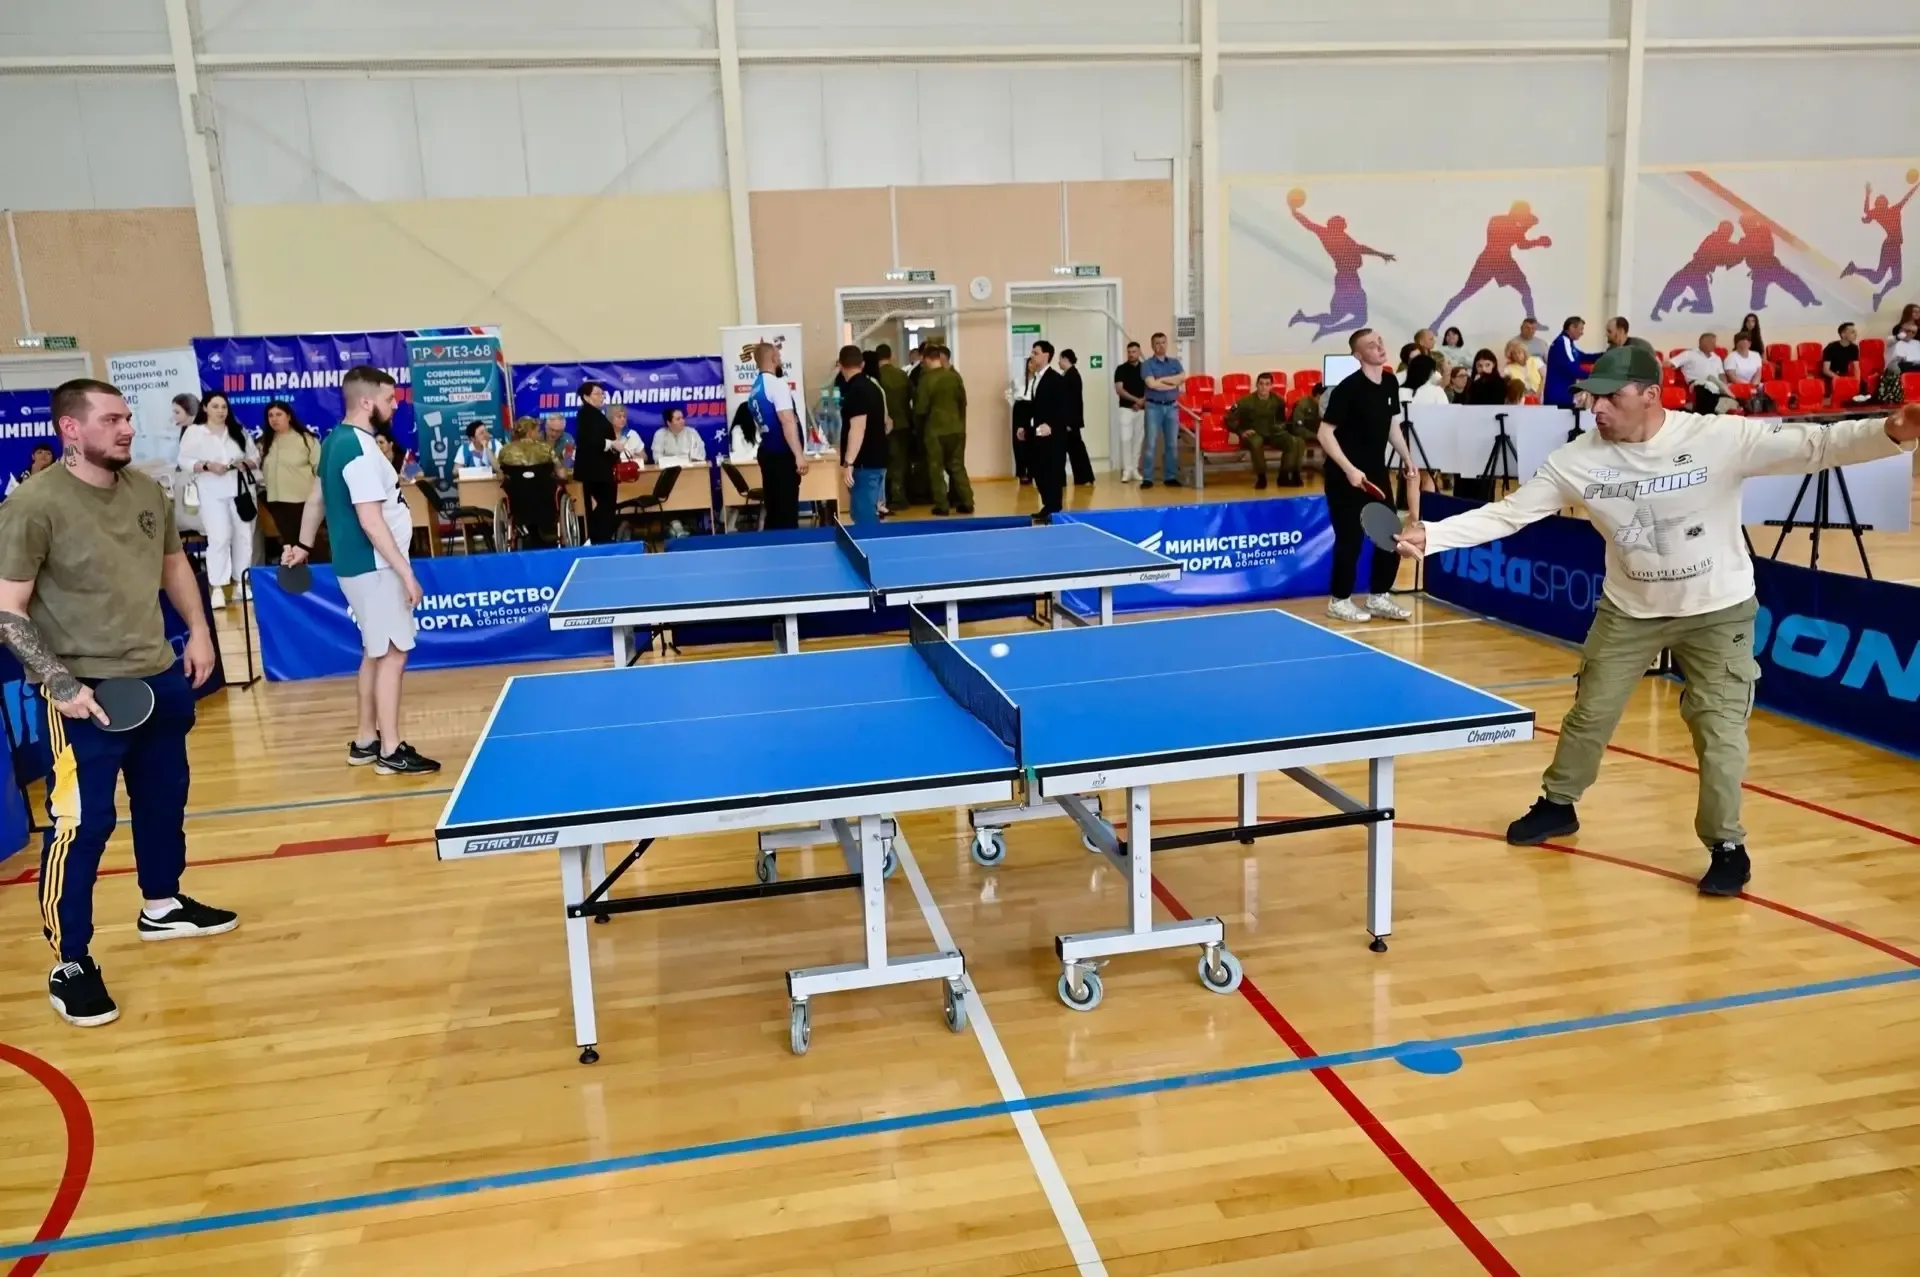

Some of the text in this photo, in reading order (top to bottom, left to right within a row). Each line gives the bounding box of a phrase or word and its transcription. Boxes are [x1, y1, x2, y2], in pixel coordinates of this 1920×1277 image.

[111, 359, 156, 371] Простое
[113, 368, 178, 383] решение по
[1583, 466, 1708, 501] FORTUNE
[1165, 530, 1303, 555] МИНИСТЕРСТВО
[1235, 546, 1296, 560] Тамбовской
[1176, 556, 1232, 572] ПОРТА
[1235, 557, 1276, 568] области
[1140, 571, 1170, 582] Champion
[417, 586, 555, 611] НИСТЕРСТВО
[475, 603, 549, 619] Тамбовской
[413, 614, 474, 631] ОРТА
[477, 615, 526, 627] области
[1753, 605, 1920, 702] ON
[1467, 726, 1516, 743] Champion
[467, 833, 555, 852] START LINE
